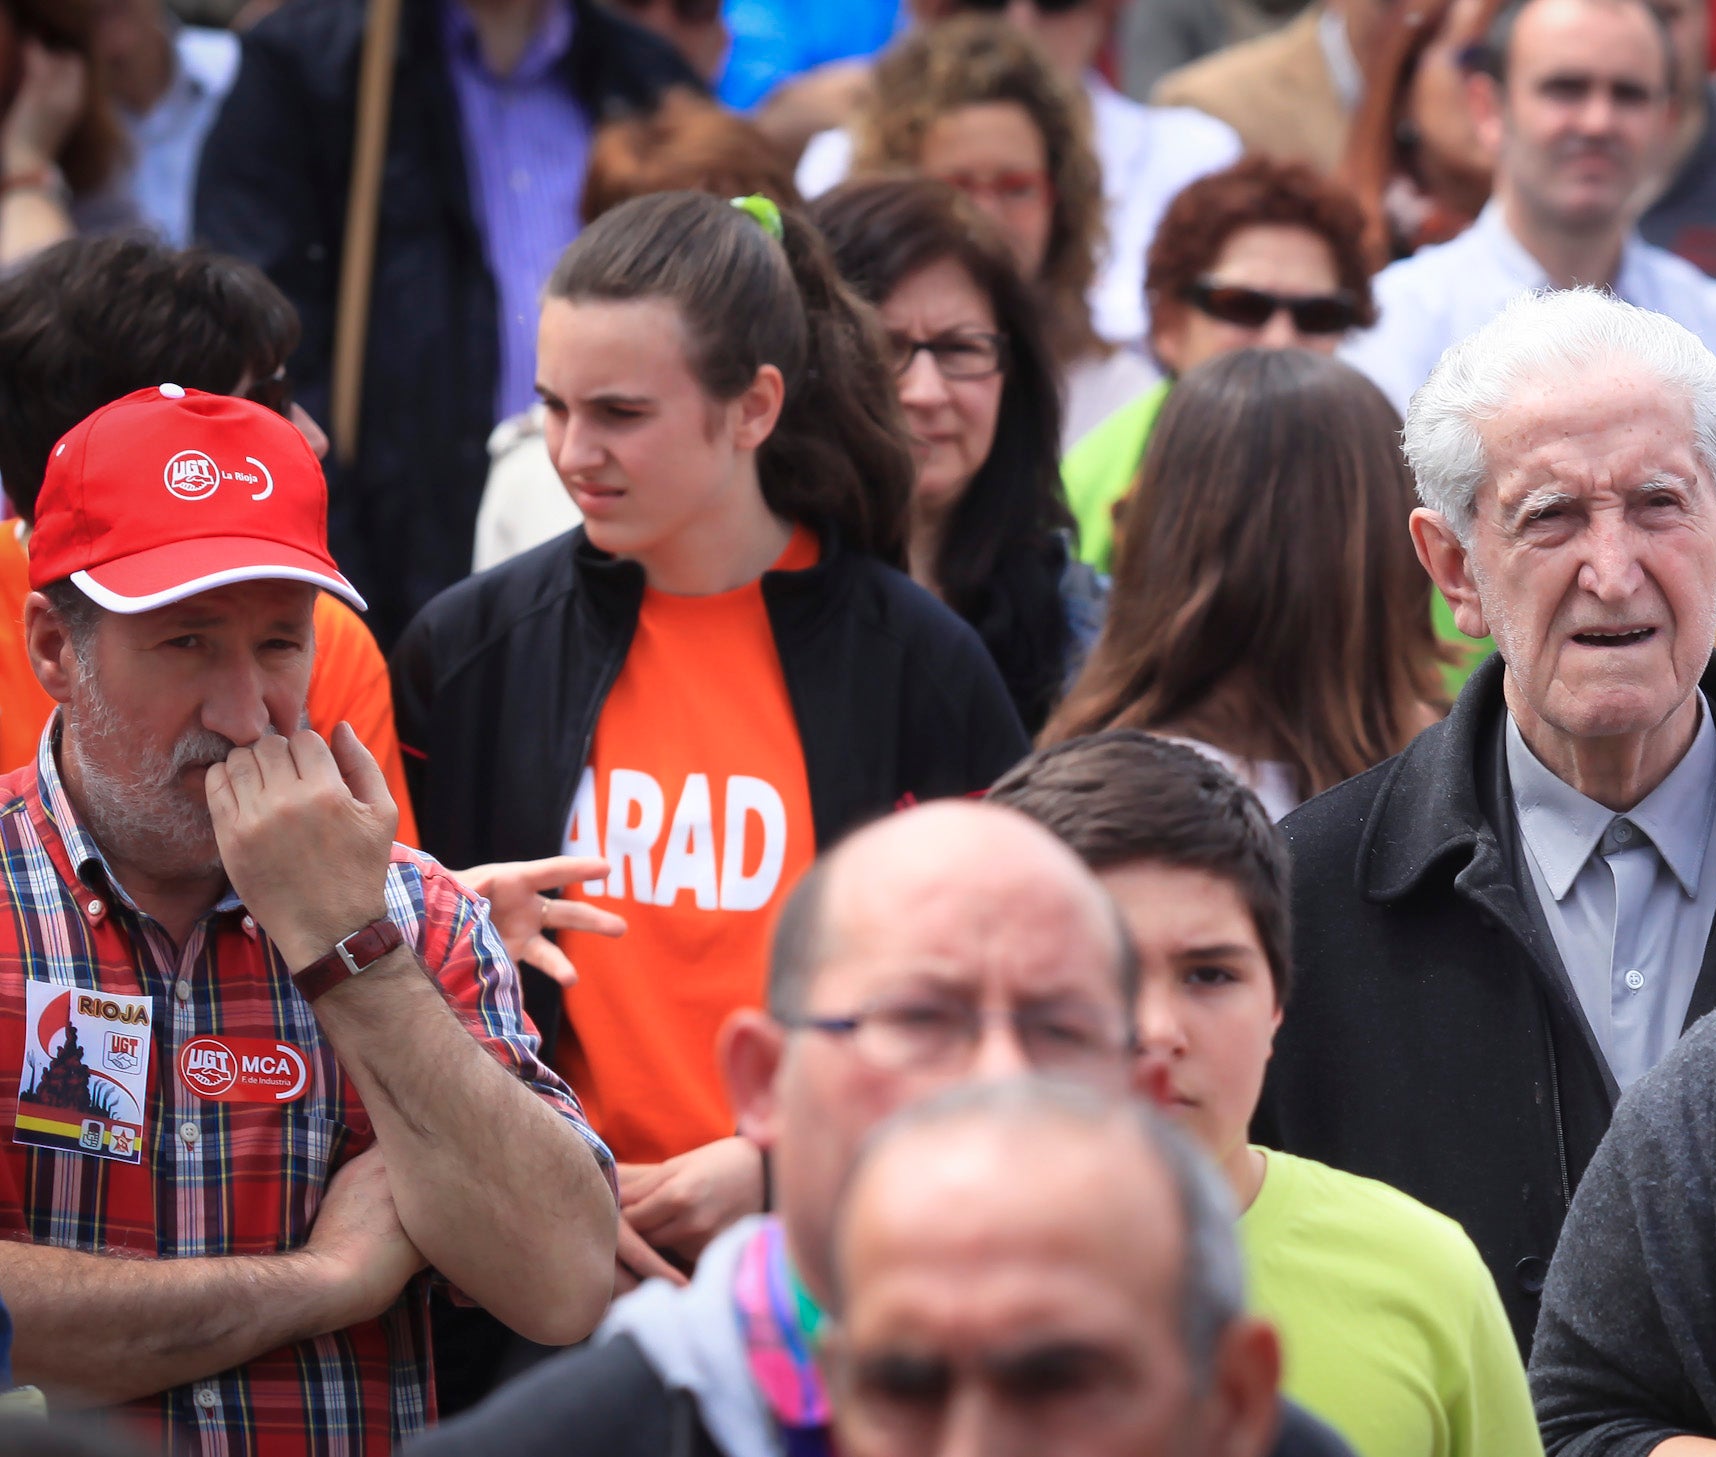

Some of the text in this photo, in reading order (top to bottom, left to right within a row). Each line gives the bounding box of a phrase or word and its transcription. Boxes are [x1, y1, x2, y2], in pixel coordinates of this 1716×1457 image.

[172, 459, 211, 482] UGT
[221, 470, 259, 484] La Rioja
[77, 995, 150, 1027] RIOJA
[112, 1034, 139, 1058] UGT
[188, 1048, 229, 1073] UGT
[241, 1055, 292, 1076] MCA
[258, 1077, 292, 1087] Industria
